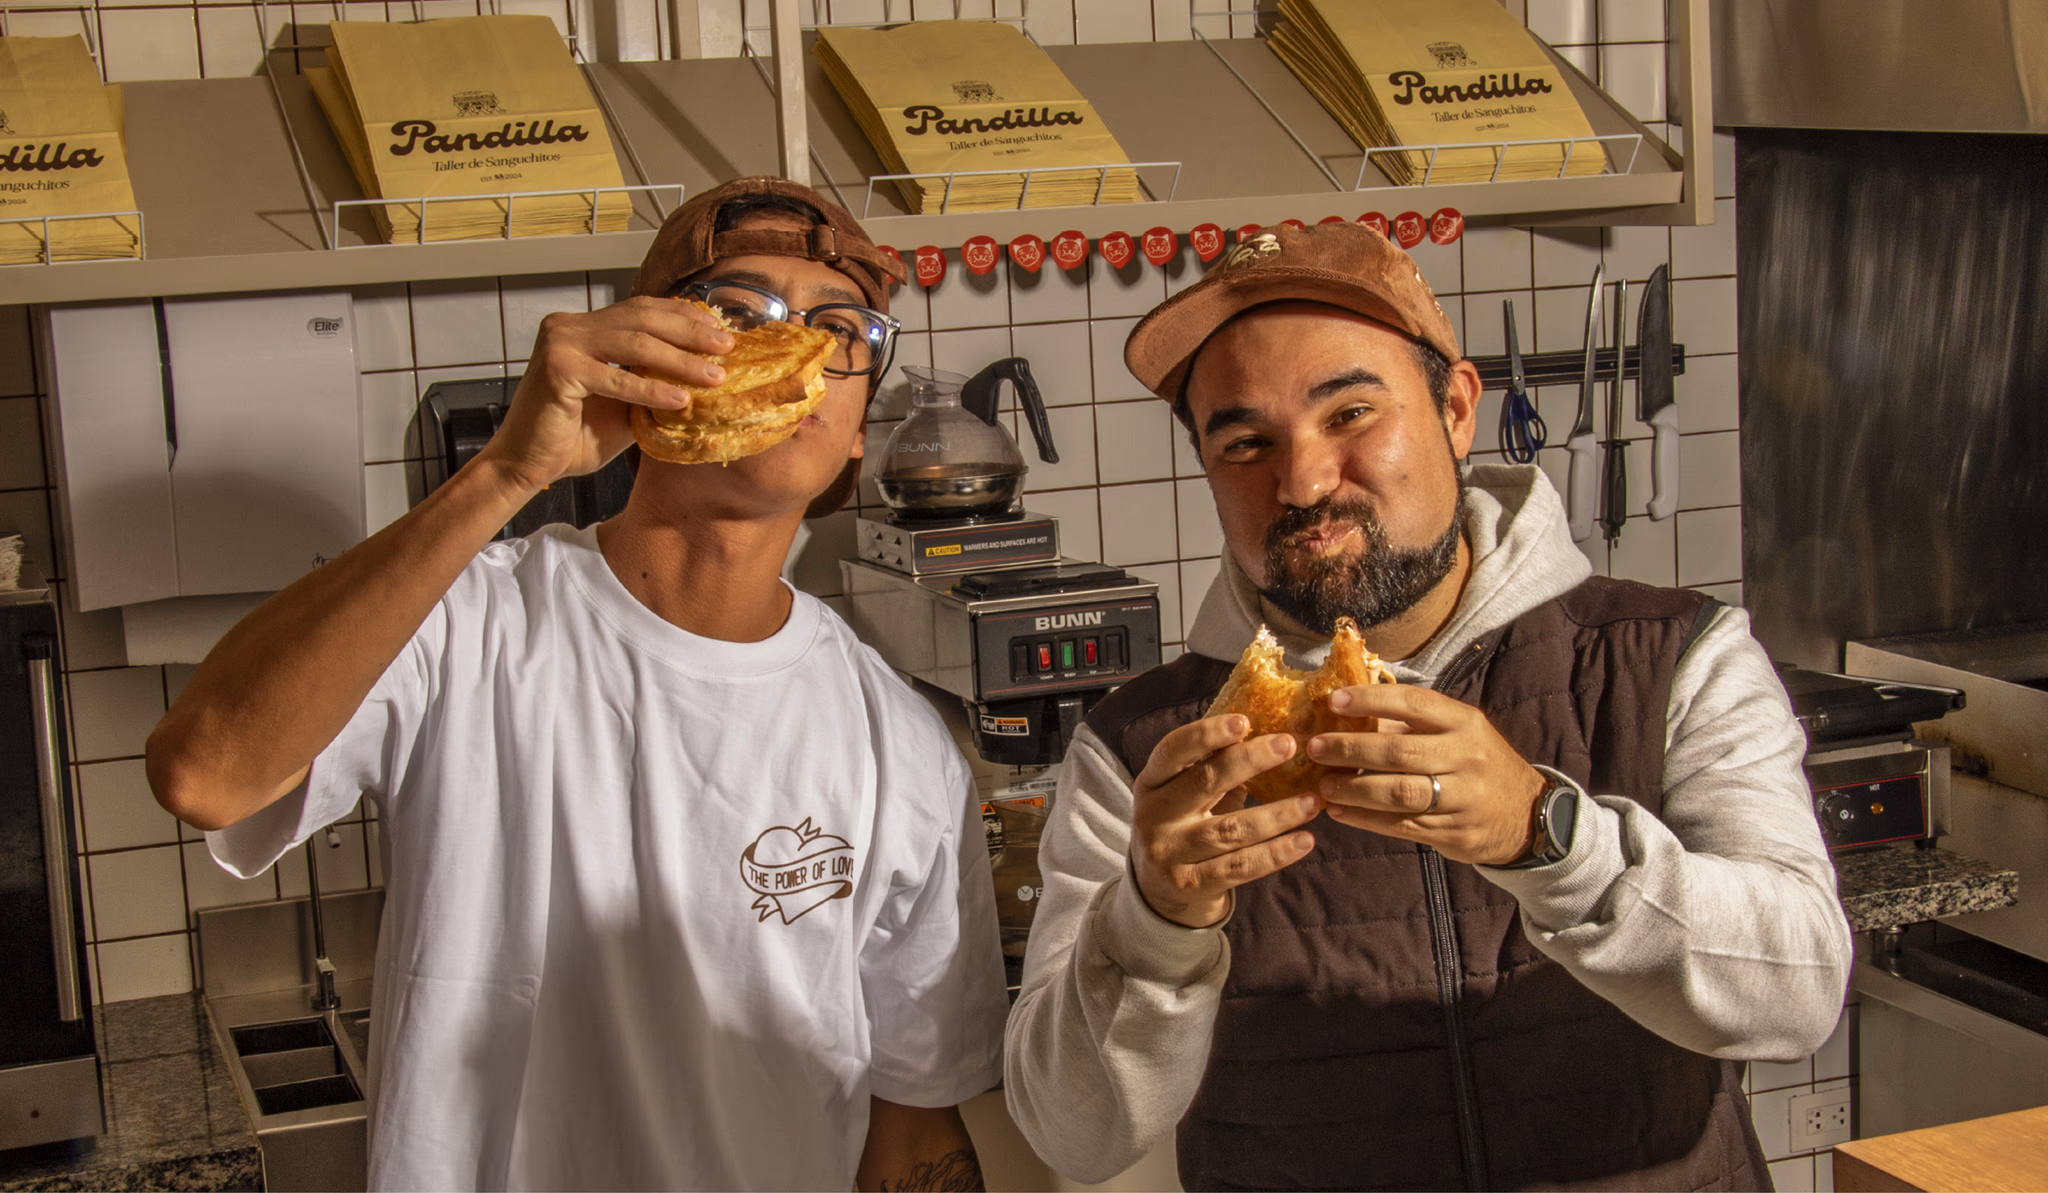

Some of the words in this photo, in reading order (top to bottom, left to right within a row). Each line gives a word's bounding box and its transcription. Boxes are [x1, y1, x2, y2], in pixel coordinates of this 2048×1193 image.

[1389, 71, 1552, 105] Pandilla
[903, 105, 1084, 135] Pandilla
[1431, 112, 1460, 122] Taller
[1461, 110, 1474, 119] de
[1474, 105, 1537, 118] Sanguchitos
[390, 119, 589, 156] Pandilla
[946, 141, 978, 150] Taller
[979, 138, 993, 147] de
[994, 133, 1063, 145] Sanguchitos
[0, 142, 104, 172] dilla
[432, 160, 467, 172] Taller
[468, 158, 483, 169] de
[485, 153, 560, 168] Sanguchitos
[314, 321, 340, 332] Elite
[898, 442, 950, 453] BUNN
[935, 546, 960, 555] CAUTION
[963, 542, 989, 551] WARMERS
[989, 541, 1000, 549] AND
[1000, 539, 1026, 548] SURFACES
[1035, 611, 1102, 631] BUNN
[748, 865, 769, 889] THE
[775, 866, 807, 890] POWER
[813, 860, 826, 880] OF
